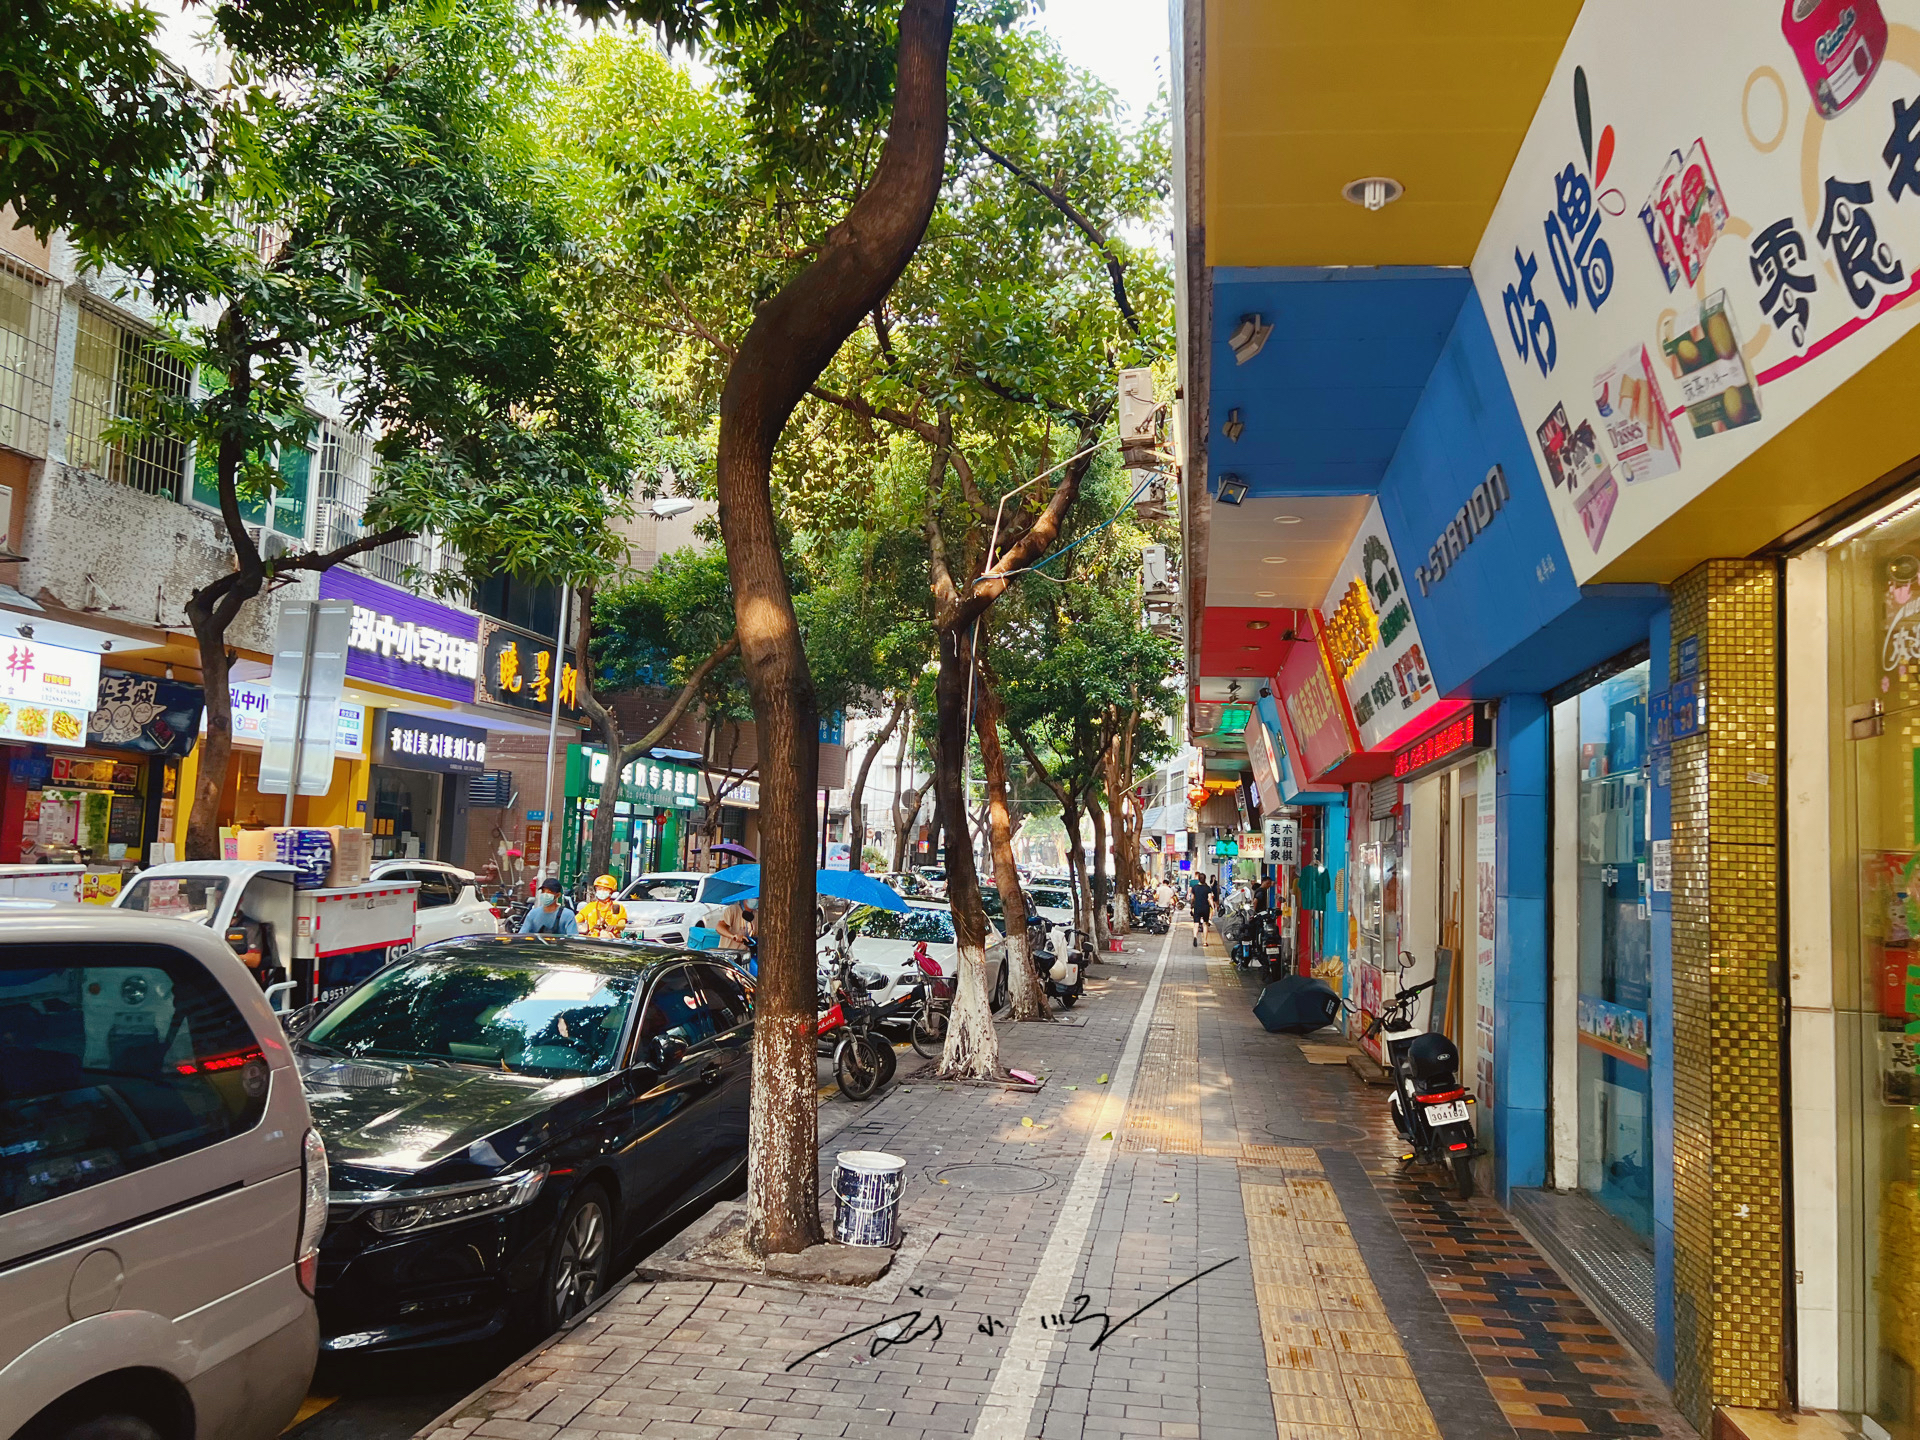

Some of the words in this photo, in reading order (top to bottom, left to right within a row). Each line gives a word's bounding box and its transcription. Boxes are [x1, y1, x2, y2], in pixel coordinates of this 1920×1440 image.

[1502, 162, 1613, 379] 咕噜
[1415, 463, 1510, 597] T-STATION
[6, 645, 35, 683] 拌
[1270, 823, 1293, 835] 美术
[1270, 836, 1293, 848] 舞蹈
[1270, 849, 1293, 861] 象棋
